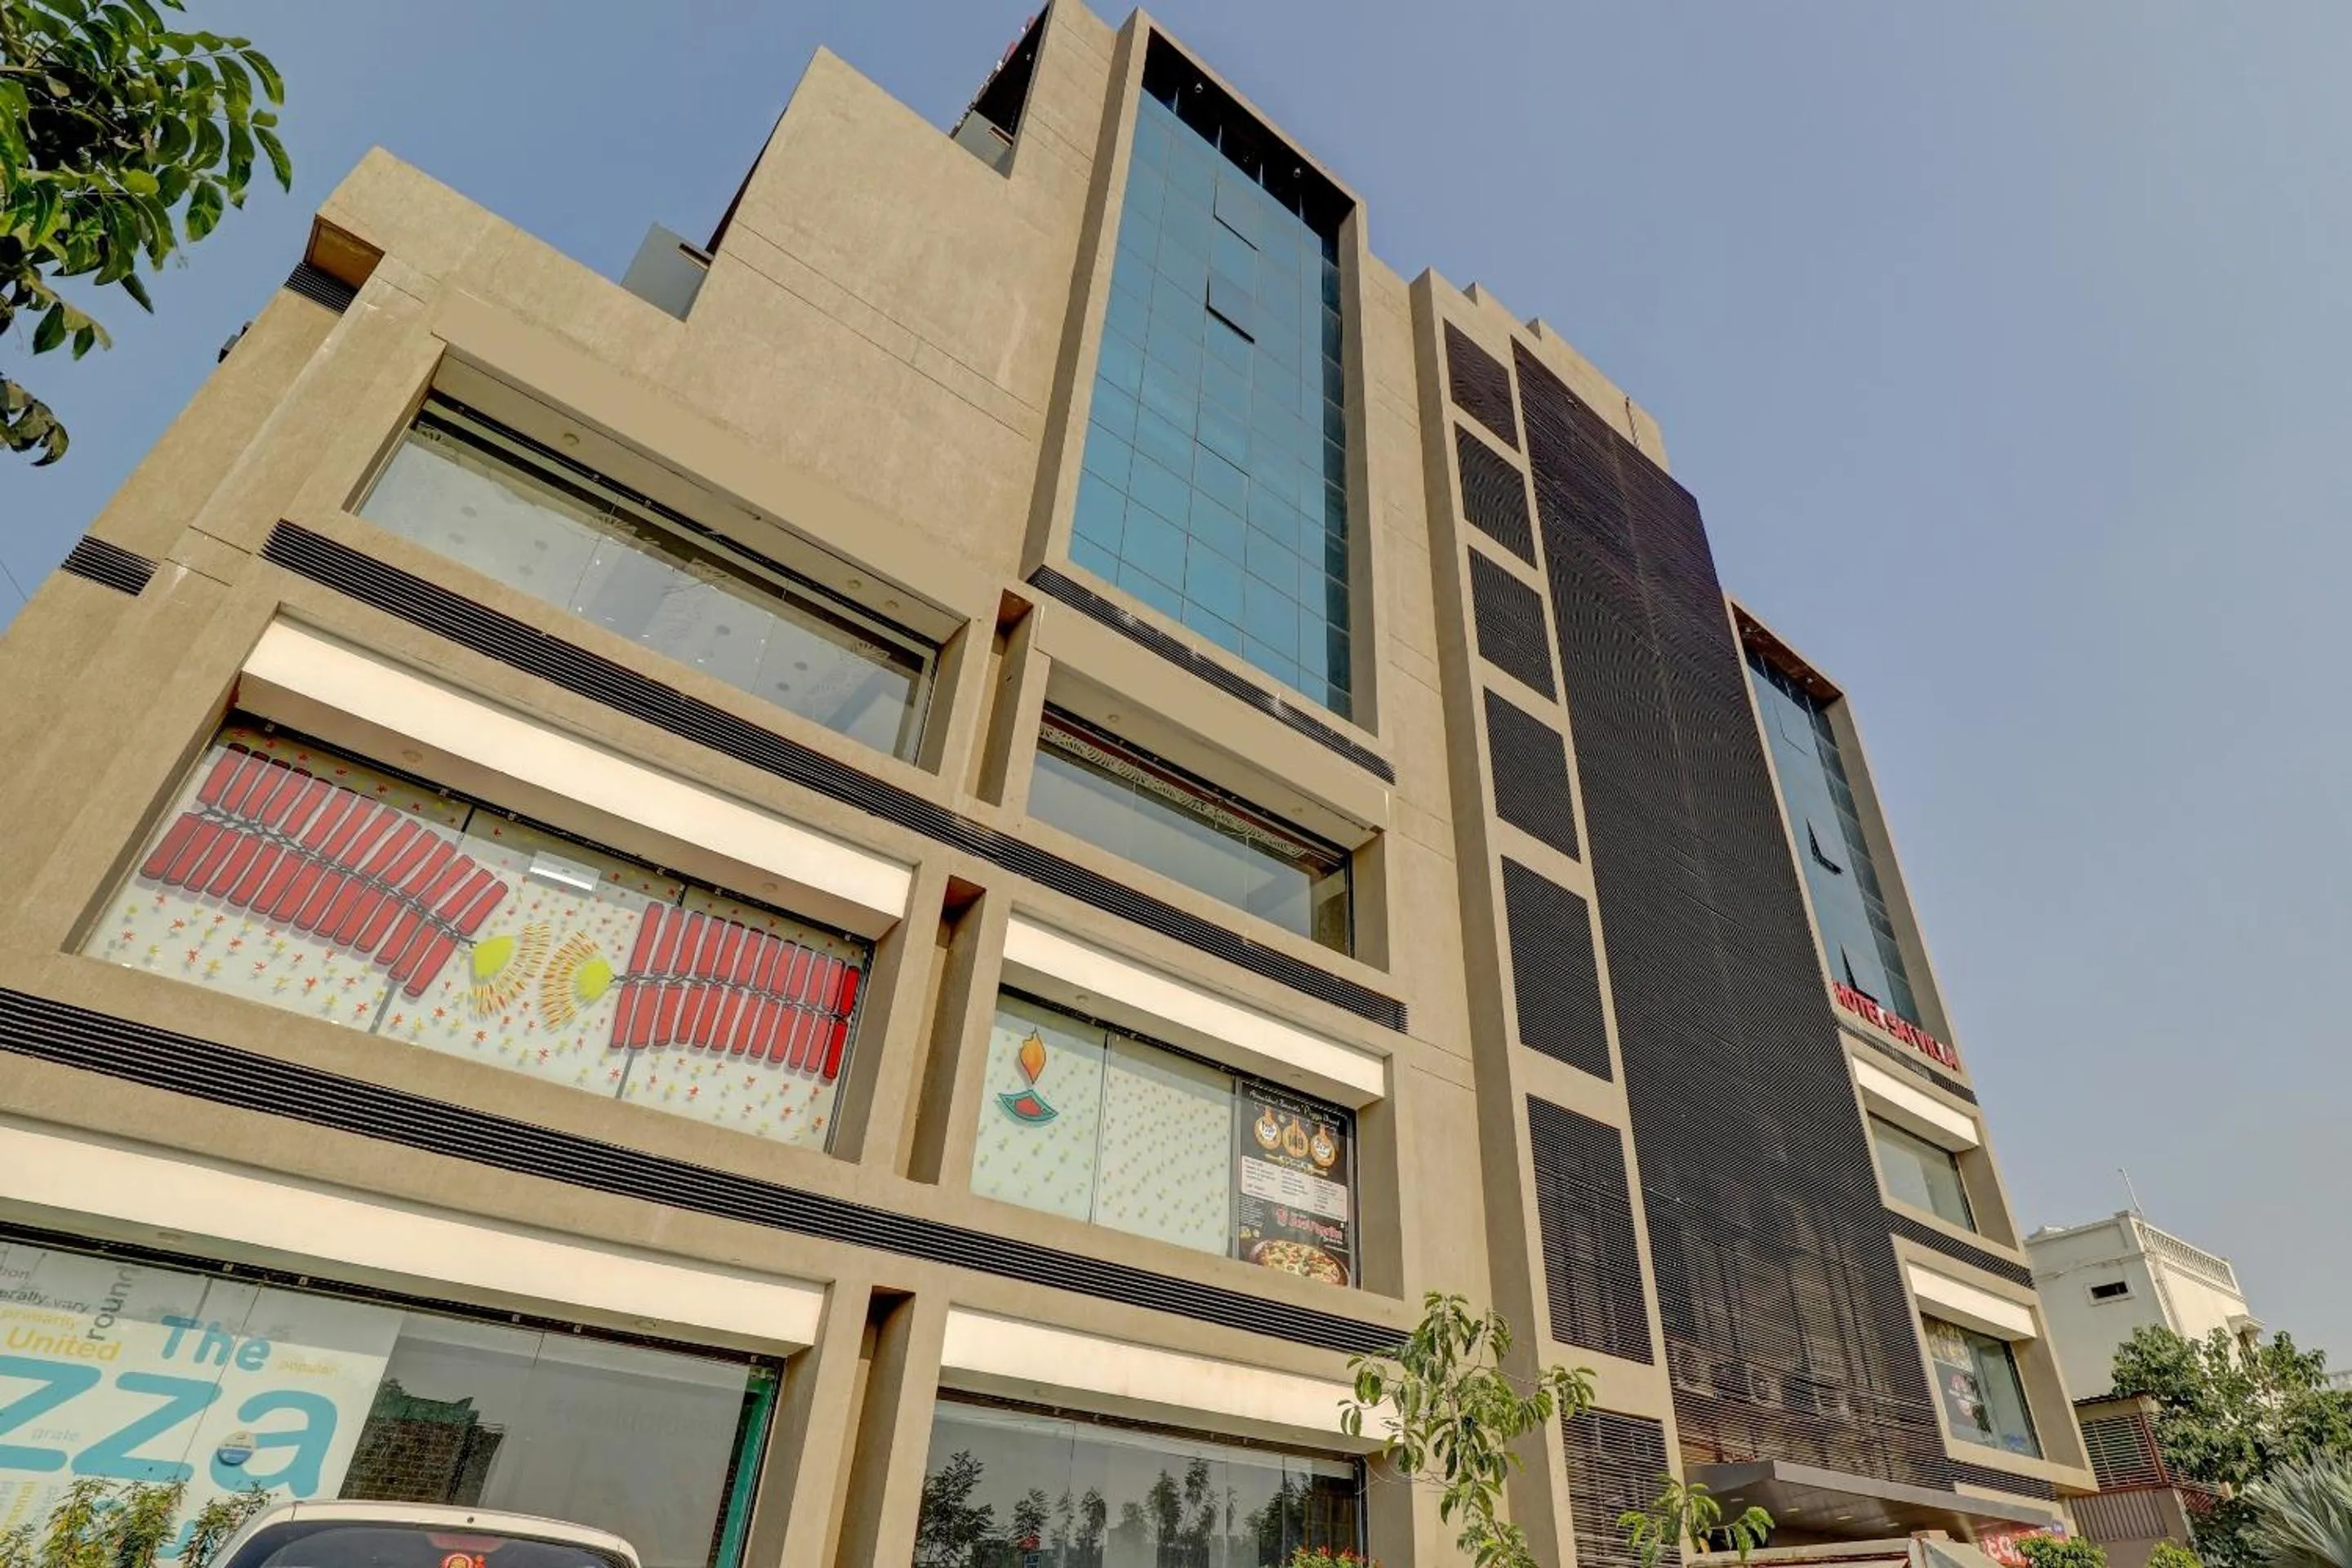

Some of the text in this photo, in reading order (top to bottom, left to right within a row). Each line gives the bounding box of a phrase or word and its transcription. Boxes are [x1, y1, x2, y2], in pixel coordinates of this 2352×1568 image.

[1830, 980, 1888, 1031] HOTEL
[7, 1325, 122, 1361] United
[162, 1314, 271, 1371] The
